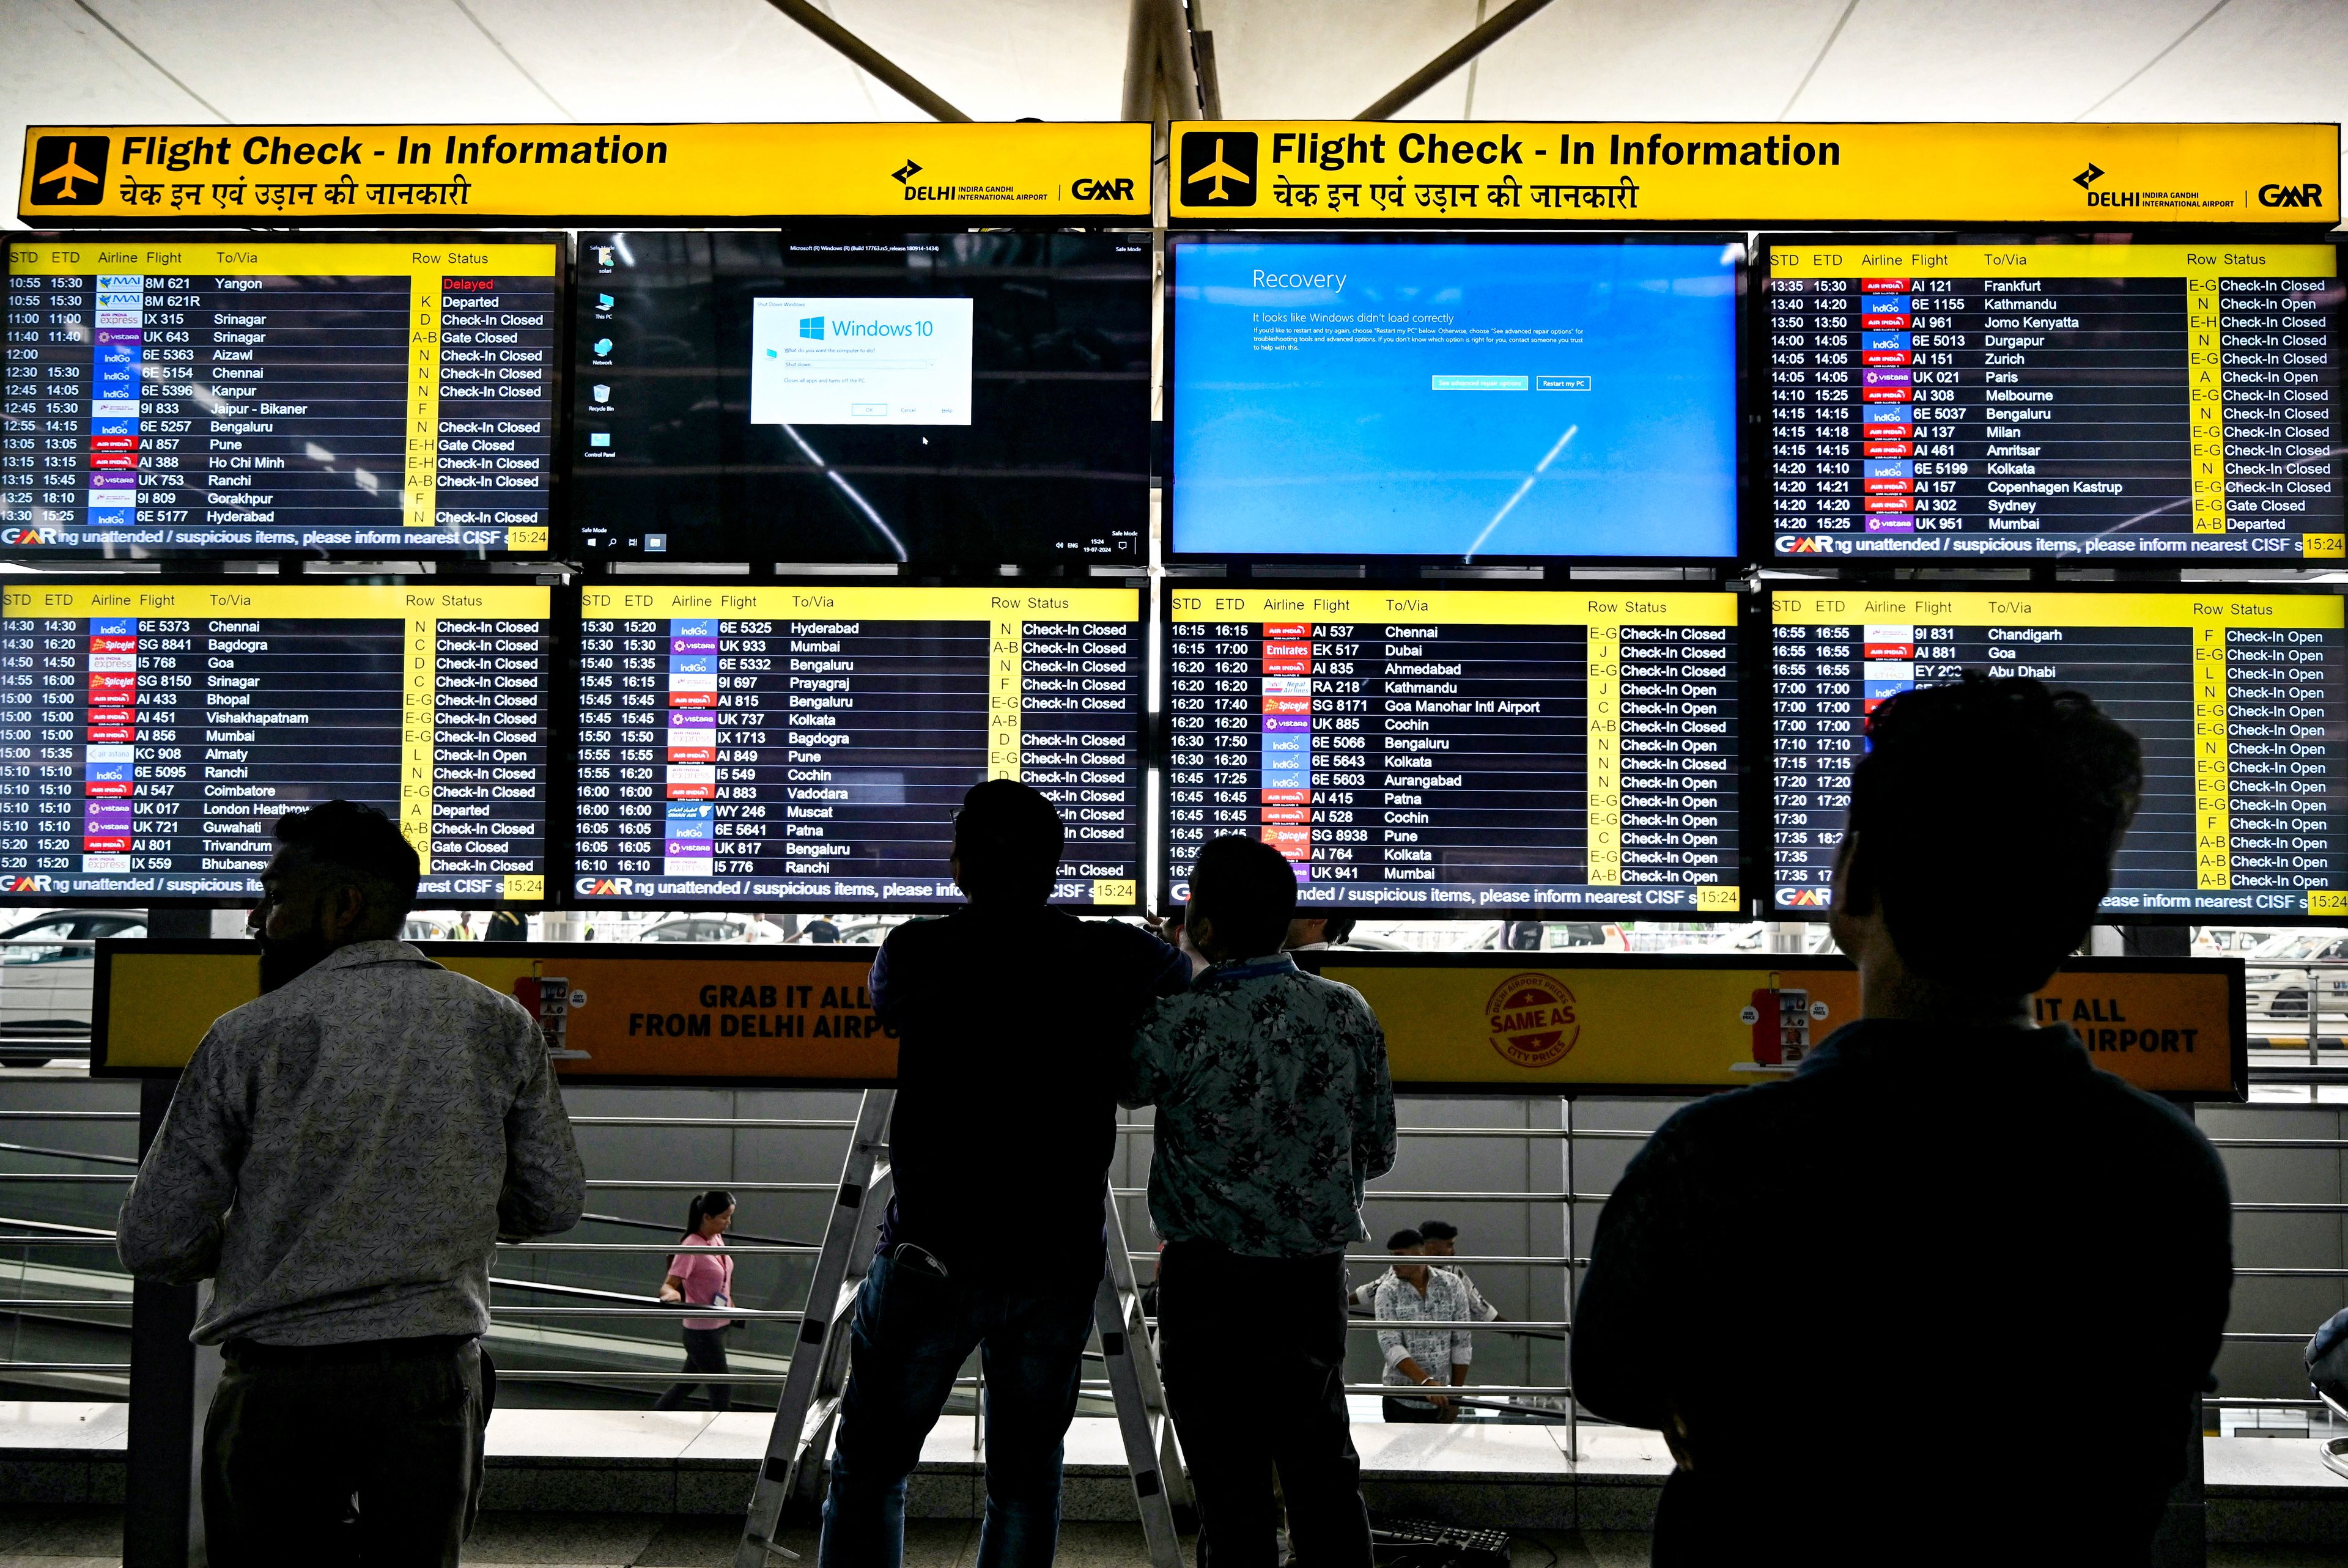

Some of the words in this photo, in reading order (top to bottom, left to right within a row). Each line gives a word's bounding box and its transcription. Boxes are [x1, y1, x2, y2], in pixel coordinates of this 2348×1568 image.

[122, 136, 231, 171] Flight
[243, 136, 363, 164] Check
[397, 136, 430, 164] In
[446, 134, 666, 164] Information
[1273, 133, 1385, 171] Flight
[1399, 133, 1523, 164] Check
[1560, 134, 1594, 164] In
[1611, 133, 1839, 165] Information
[120, 175, 164, 205] चेक
[171, 184, 205, 210] इन
[212, 175, 246, 209] एवं
[255, 184, 317, 211] उड़ान
[325, 174, 359, 204] की
[366, 174, 471, 205] जानकारी
[905, 186, 955, 201] DELHI
[1273, 175, 1320, 207] चेक
[1327, 185, 1361, 212] इन
[1370, 175, 1406, 211] एवं
[1414, 185, 1479, 213] उड़ान
[1487, 175, 1523, 207] की
[1530, 175, 1639, 209] जानकारी
[2088, 192, 2139, 207] DELHI
[10, 251, 38, 263] STD
[53, 252, 79, 263] ETD
[98, 252, 138, 263] Airline
[147, 252, 181, 265] Flight
[216, 252, 257, 263] To/Via
[413, 253, 440, 263] Row
[448, 253, 488, 263] Status
[10, 278, 40, 287] 10:55
[51, 278, 82, 287] 15:30
[146, 278, 164, 288] 8M
[168, 278, 189, 289] 621
[215, 278, 262, 291] Yangon
[444, 279, 493, 292] Delayed
[1254, 270, 1346, 293] Recovery
[832, 320, 912, 336] Windows
[915, 321, 932, 336] 10
[1253, 313, 1259, 322] It
[1263, 312, 1287, 322] looks
[1291, 313, 1306, 322] like
[1310, 313, 1354, 322] Windows
[1389, 313, 1409, 322] load
[1412, 313, 1453, 325] correctly
[1771, 317, 1803, 328] 13:50
[1815, 317, 1847, 328] 13:50
[1912, 317, 1925, 328] AI
[1929, 317, 1951, 328] 961
[1985, 317, 2019, 328] Jomo
[2023, 317, 2079, 330] Kenyatta
[2191, 316, 2216, 328] E-H
[2221, 317, 2278, 327] Check-In
[2283, 317, 2325, 327] Closed
[6, 385, 37, 395] 12:45
[47, 385, 78, 395] 14:05
[103, 389, 129, 399] IndiGo
[142, 385, 158, 396] 6E
[162, 384, 194, 397] 5396
[212, 385, 257, 400] Kanpur
[419, 386, 427, 396] N
[440, 386, 495, 397] Check-In
[500, 386, 541, 397] Closed
[1773, 627, 1806, 638] 16:55
[1816, 627, 1849, 638] 16:55
[1931, 628, 1953, 639] 831
[1988, 628, 2062, 643] Chandigarh
[2206, 630, 2213, 641] F
[2227, 631, 2284, 642] Check-In
[2288, 631, 2322, 645] Open
[1172, 643, 1205, 654] 16:15
[1216, 644, 1248, 654] 17:00
[1267, 646, 1308, 655] Emirates
[1313, 644, 1332, 655] EK
[1335, 644, 1359, 655] 517
[1386, 645, 1422, 656] Dubai
[1600, 646, 1606, 657] J
[1621, 647, 1677, 658] Check-In
[1682, 647, 1726, 658] Closed
[1, 675, 32, 685] 14:55
[43, 675, 74, 685] 16:00
[138, 675, 157, 686] SG
[161, 675, 191, 686] 8150
[207, 675, 259, 690] Srinagar
[415, 676, 424, 686] C
[436, 676, 491, 687] Check-In
[495, 676, 537, 687] Closed
[580, 713, 611, 723] 15:45
[622, 713, 654, 724] 15:45
[718, 713, 737, 724] UK
[741, 713, 764, 725] 737
[789, 714, 835, 725] Kolkata
[992, 715, 1017, 726] A-B
[700, 985, 777, 1008] GRAB
[787, 985, 813, 1008] IT
[1493, 992, 1508, 1012] DELHI
[1508, 979, 1542, 992] AIRPORT
[1545, 982, 1568, 1004] PRICES
[1491, 1010, 1546, 1033] SAME
[1551, 1006, 1575, 1025] AS
[2073, 999, 2125, 1022] ALL
[629, 1014, 711, 1037] FROM
[721, 1014, 803, 1037] DELHI
[2074, 1029, 2198, 1052] IRPORT
[1508, 1046, 1530, 1061] CITY
[1532, 1040, 1565, 1062] PRICES
